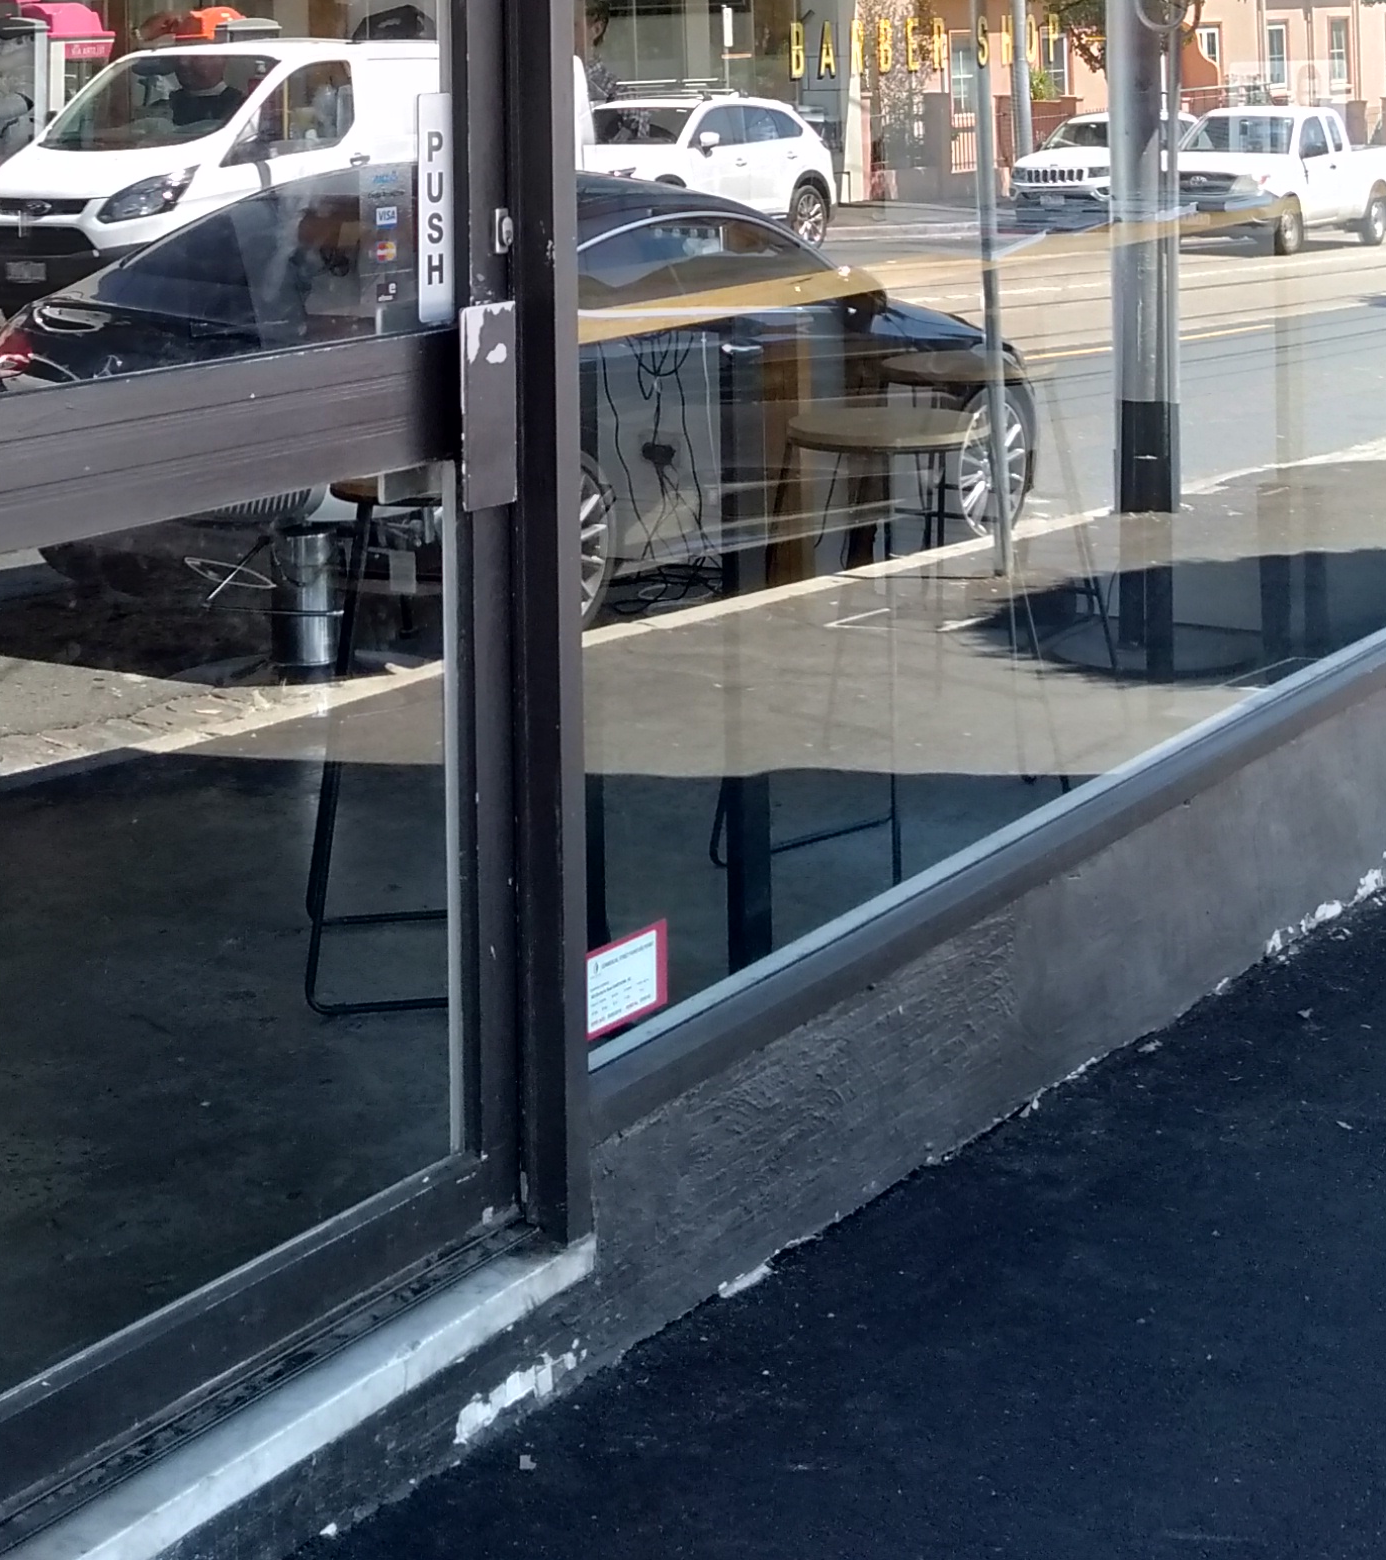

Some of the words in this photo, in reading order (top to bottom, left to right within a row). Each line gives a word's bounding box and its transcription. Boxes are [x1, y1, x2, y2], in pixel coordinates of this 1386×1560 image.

[789, 16, 948, 80] BARBER
[976, 12, 1060, 68] SHOP
[377, 209, 396, 223] VISA
[427, 130, 444, 286] PUSH
